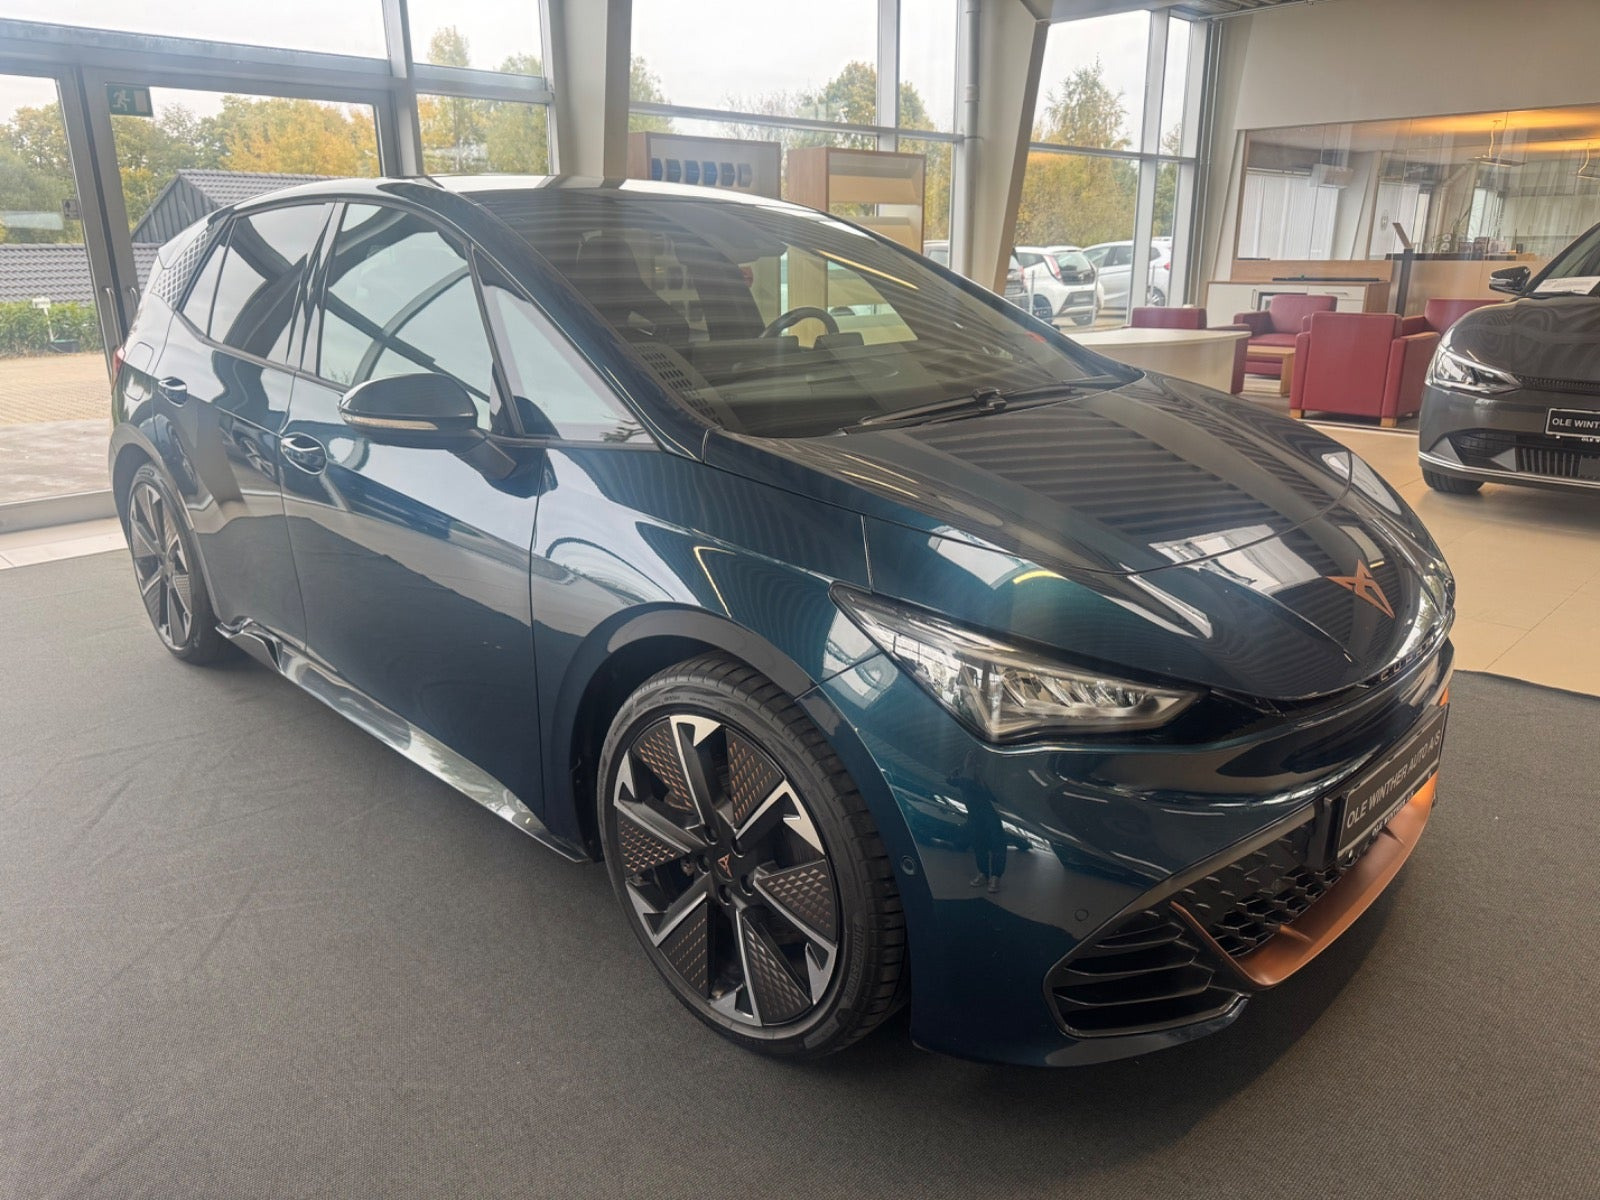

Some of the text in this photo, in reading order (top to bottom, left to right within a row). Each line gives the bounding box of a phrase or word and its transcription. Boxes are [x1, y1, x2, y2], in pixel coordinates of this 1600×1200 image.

[1552, 418, 1600, 429] OLE WINT
[1346, 799, 1368, 829] OLE
[1368, 763, 1408, 811] WINTHER
[1407, 743, 1429, 774] AUTO
